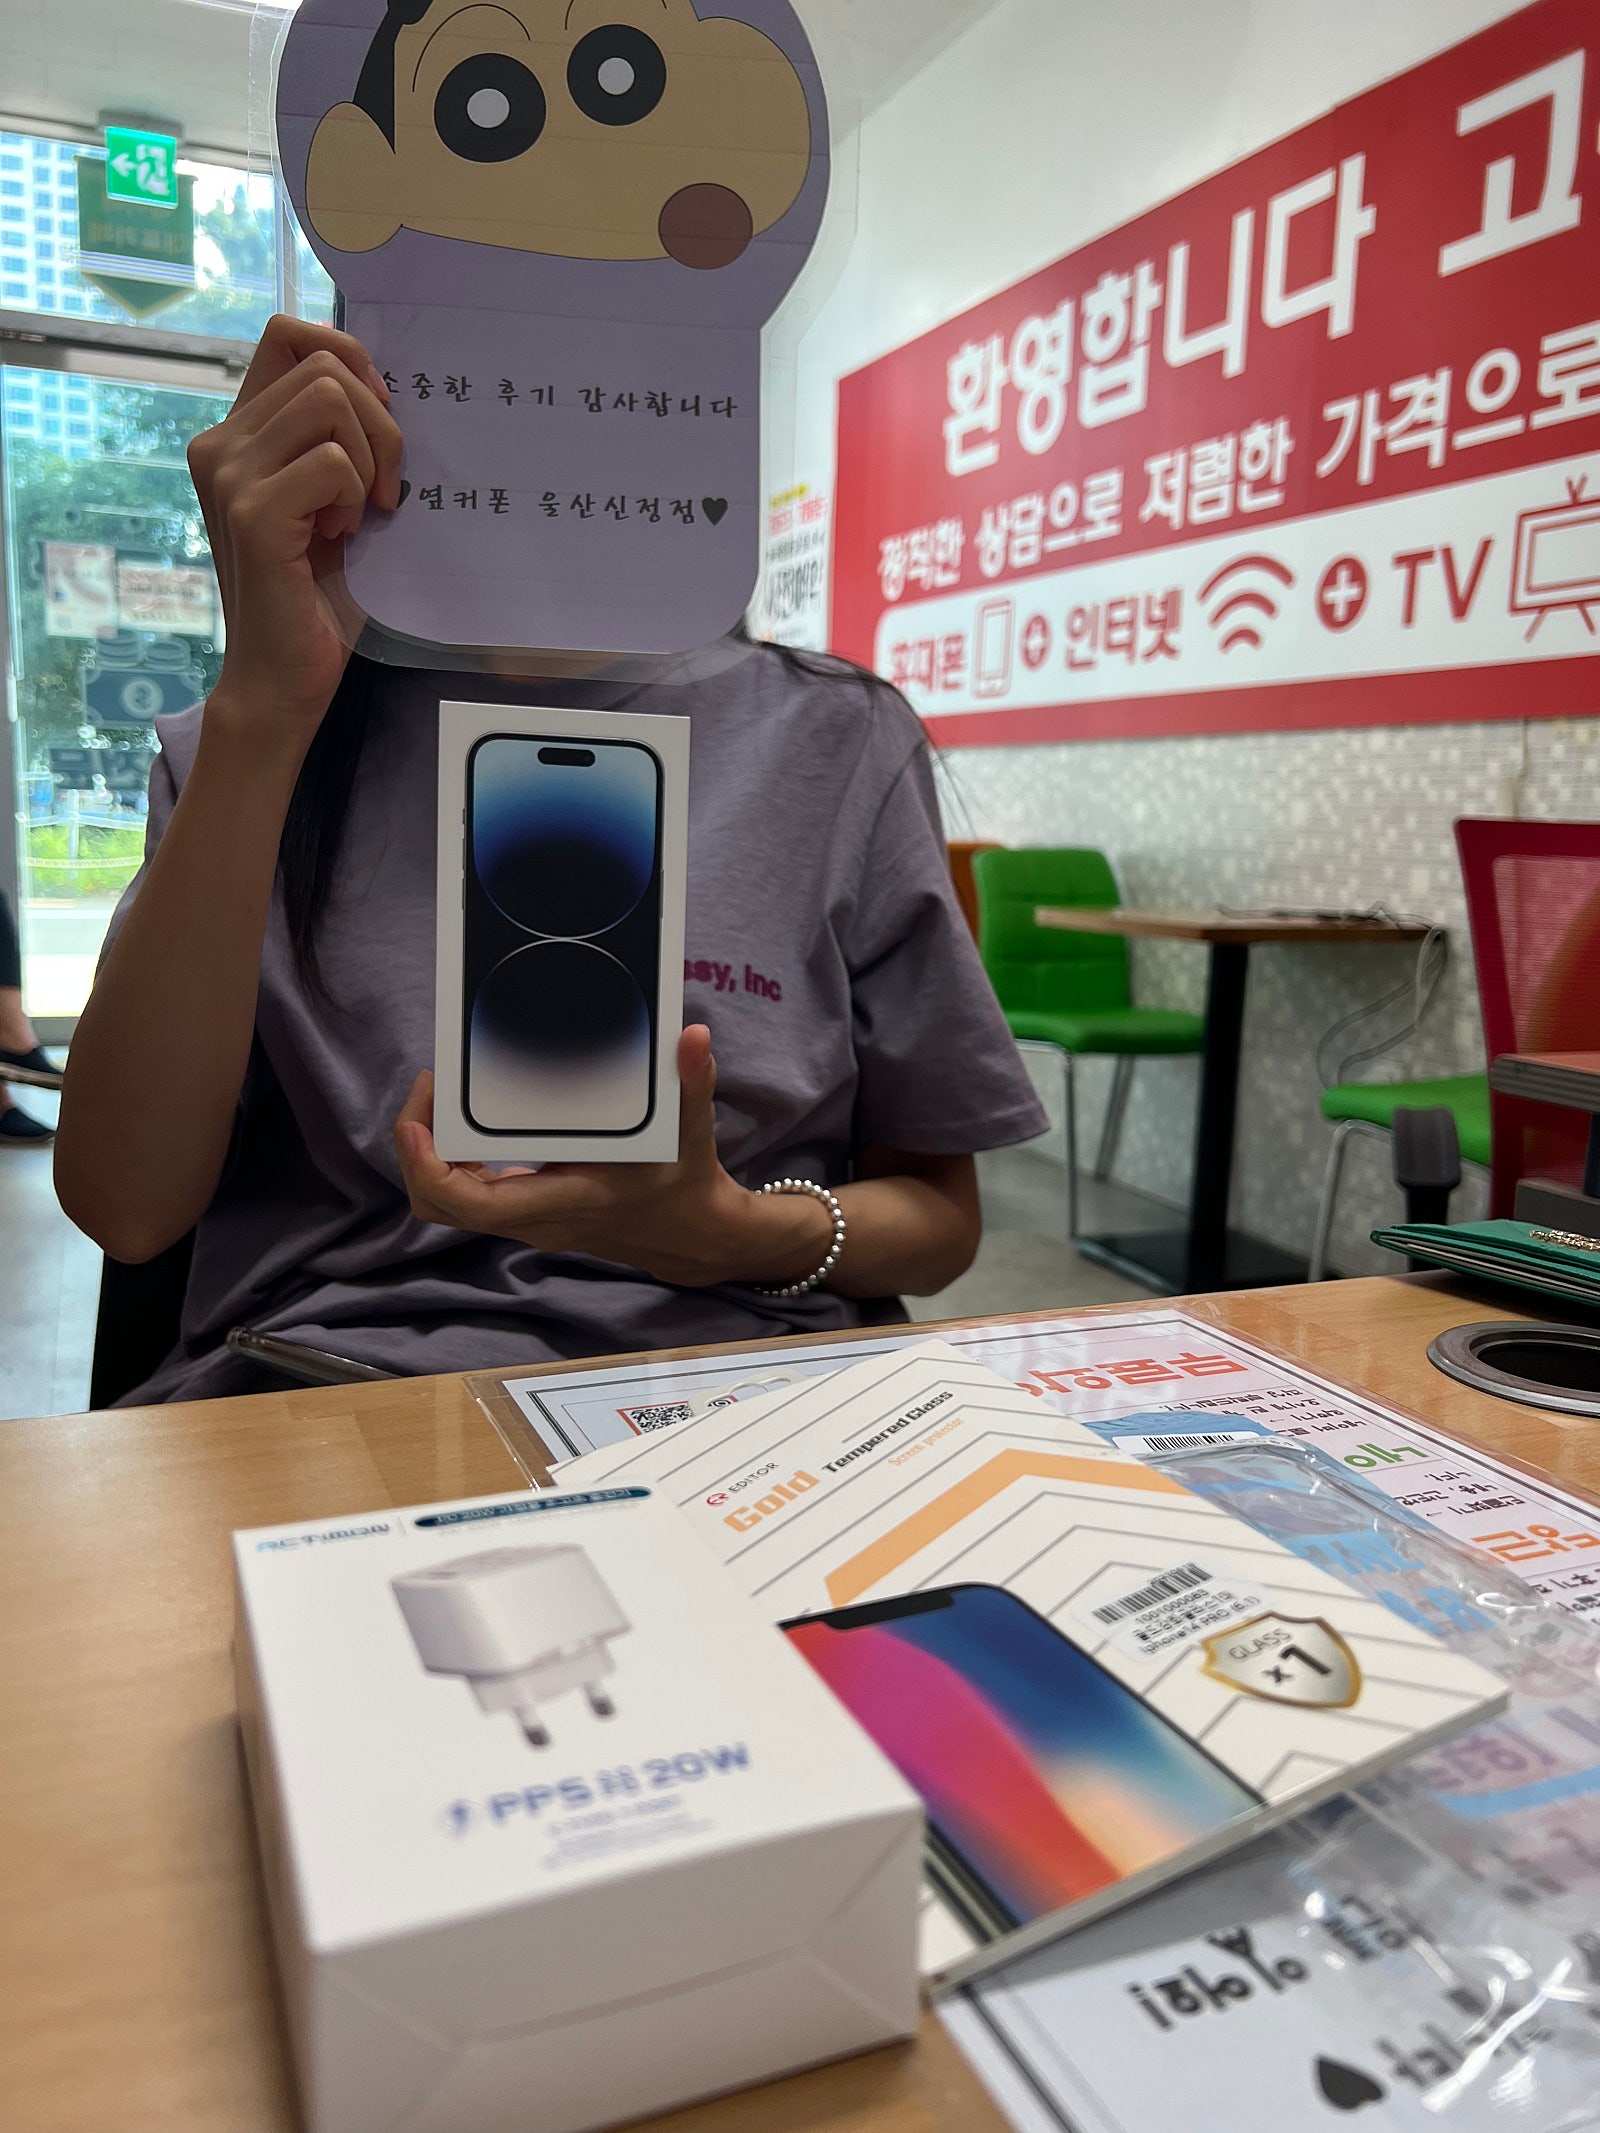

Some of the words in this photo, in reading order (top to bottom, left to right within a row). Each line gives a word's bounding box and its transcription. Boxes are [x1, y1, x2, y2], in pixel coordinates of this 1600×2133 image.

[943, 152, 1378, 477] 환영합니다
[1436, 46, 1600, 279] 고
[382, 371, 472, 403] 소중한
[498, 378, 556, 406] 후기
[578, 386, 738, 418] 감사합니다
[974, 467, 1126, 580] 상담으로
[1138, 415, 1296, 533] 저렴한
[1315, 320, 1600, 486] 가격으로
[418, 483, 512, 514] 옆커폰
[538, 491, 696, 524] 울산신정점
[1063, 588, 1184, 672] 인터넷
[1394, 538, 1494, 628] TV
[744, 963, 782, 1002] Inc
[1311, 1419, 1367, 1434] 네이버
[722, 1469, 821, 1533] Gold
[822, 1417, 911, 1474] Tempered
[904, 1390, 954, 1422] Glass
[727, 1462, 780, 1494] EDITOR
[1448, 1482, 1500, 1496] 내용,
[1462, 1524, 1600, 1565] 당근
[1228, 1628, 1292, 1660] GLASS
